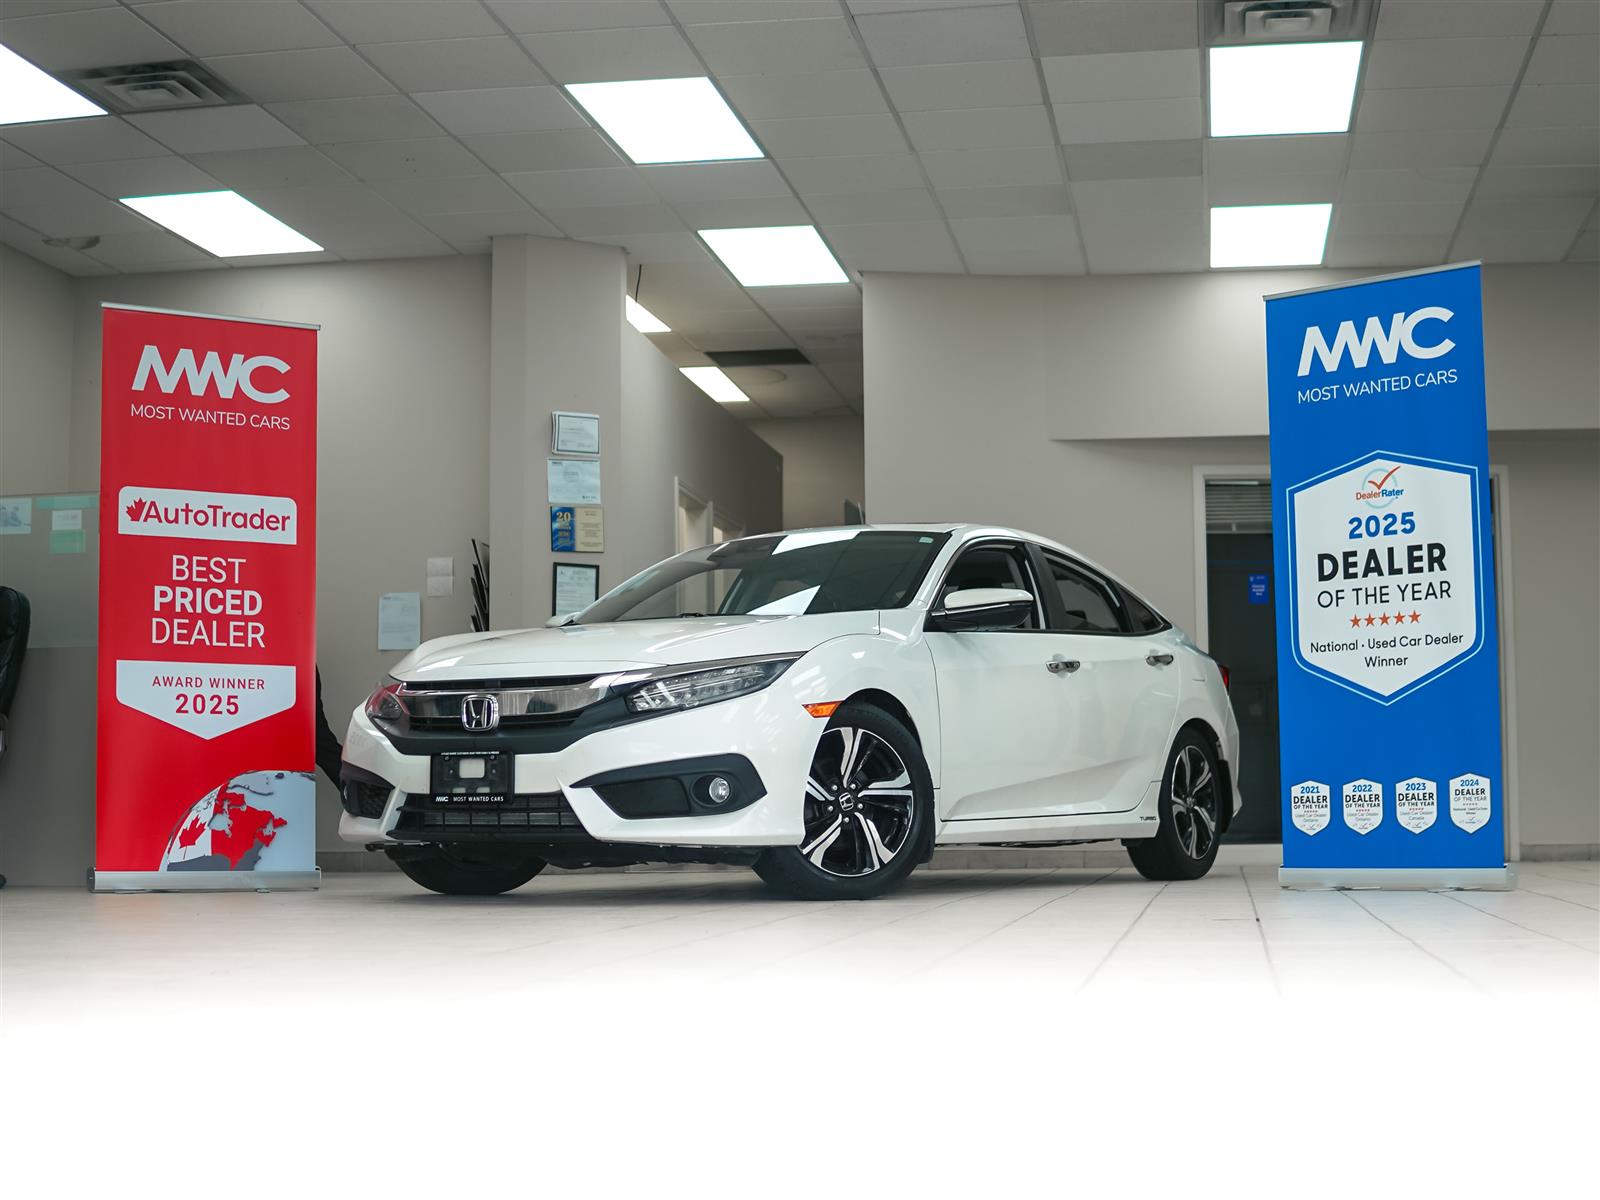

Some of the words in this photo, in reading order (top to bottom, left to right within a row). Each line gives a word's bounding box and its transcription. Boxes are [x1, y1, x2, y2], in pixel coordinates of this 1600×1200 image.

[1297, 306, 1456, 377] MWC
[131, 344, 291, 404] MWC
[1298, 385, 1340, 404] MOST
[1343, 375, 1411, 397] WANTED
[1415, 369, 1458, 388] CARS
[131, 404, 175, 421] MOST
[178, 408, 246, 427] WANTED
[250, 414, 290, 430] CARS
[1356, 488, 1404, 501] DealerRater
[143, 501, 291, 531] AutoTrader
[1348, 512, 1416, 540] 2025
[172, 554, 247, 584] BEST
[1317, 542, 1447, 582] DEALER
[153, 585, 263, 616] PRICED
[1317, 590, 1345, 609] OF
[1352, 585, 1390, 606] THE
[1396, 580, 1452, 602] YEAR
[151, 617, 266, 648] DEALER
[1310, 640, 1359, 654] National
[1367, 637, 1397, 650] Used
[1399, 635, 1422, 648] Car
[1425, 633, 1464, 646] Dealer
[1364, 655, 1408, 668] Winner
[152, 676, 203, 688] AWARD
[209, 677, 266, 690] WINNER
[175, 692, 239, 715] 2025
[1300, 786, 1320, 794] 2021
[1352, 784, 1373, 793] 2022
[1405, 783, 1427, 791] 2023
[1454, 788, 1486, 796] DEALER
[1460, 779, 1479, 787] 2024
[1293, 795, 1328, 804] DEALER
[1344, 793, 1380, 803] DEALER
[1398, 792, 1435, 802] DEALER
